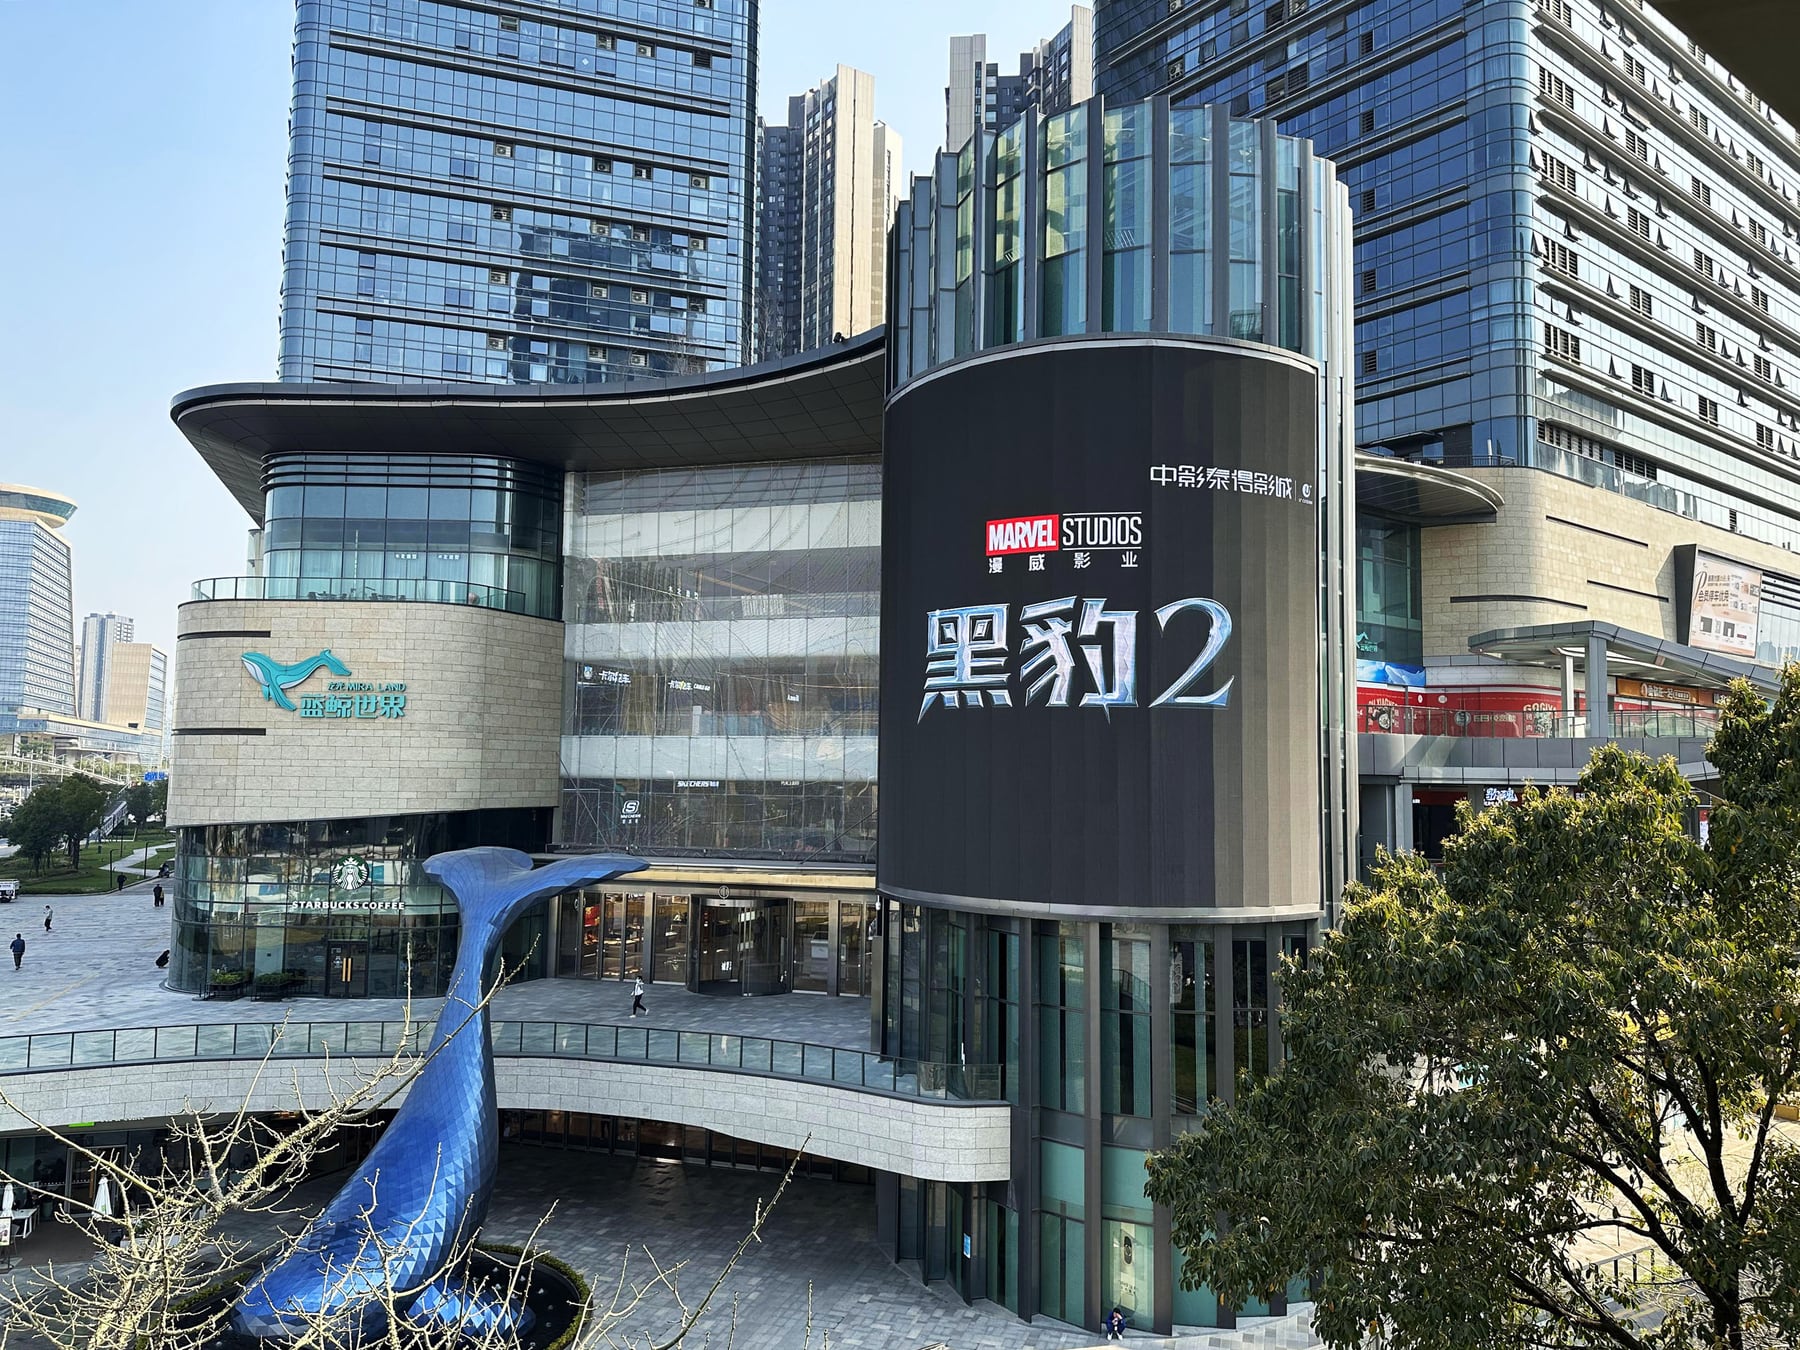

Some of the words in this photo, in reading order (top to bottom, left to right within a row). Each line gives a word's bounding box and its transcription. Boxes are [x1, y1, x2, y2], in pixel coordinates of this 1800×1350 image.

[1150, 464, 1293, 499] 中影泰得影城
[988, 519, 1057, 551] MARVEL
[1062, 516, 1143, 546] STUDIOS
[988, 551, 1139, 574] 漫威影业
[917, 595, 1236, 724] 黑豹2
[347, 682, 374, 692] MIRA
[378, 683, 407, 692] LAND
[300, 694, 406, 719] 蓝鲸世界
[291, 901, 360, 910] STARBUCKS
[361, 901, 406, 910] COFFEE
